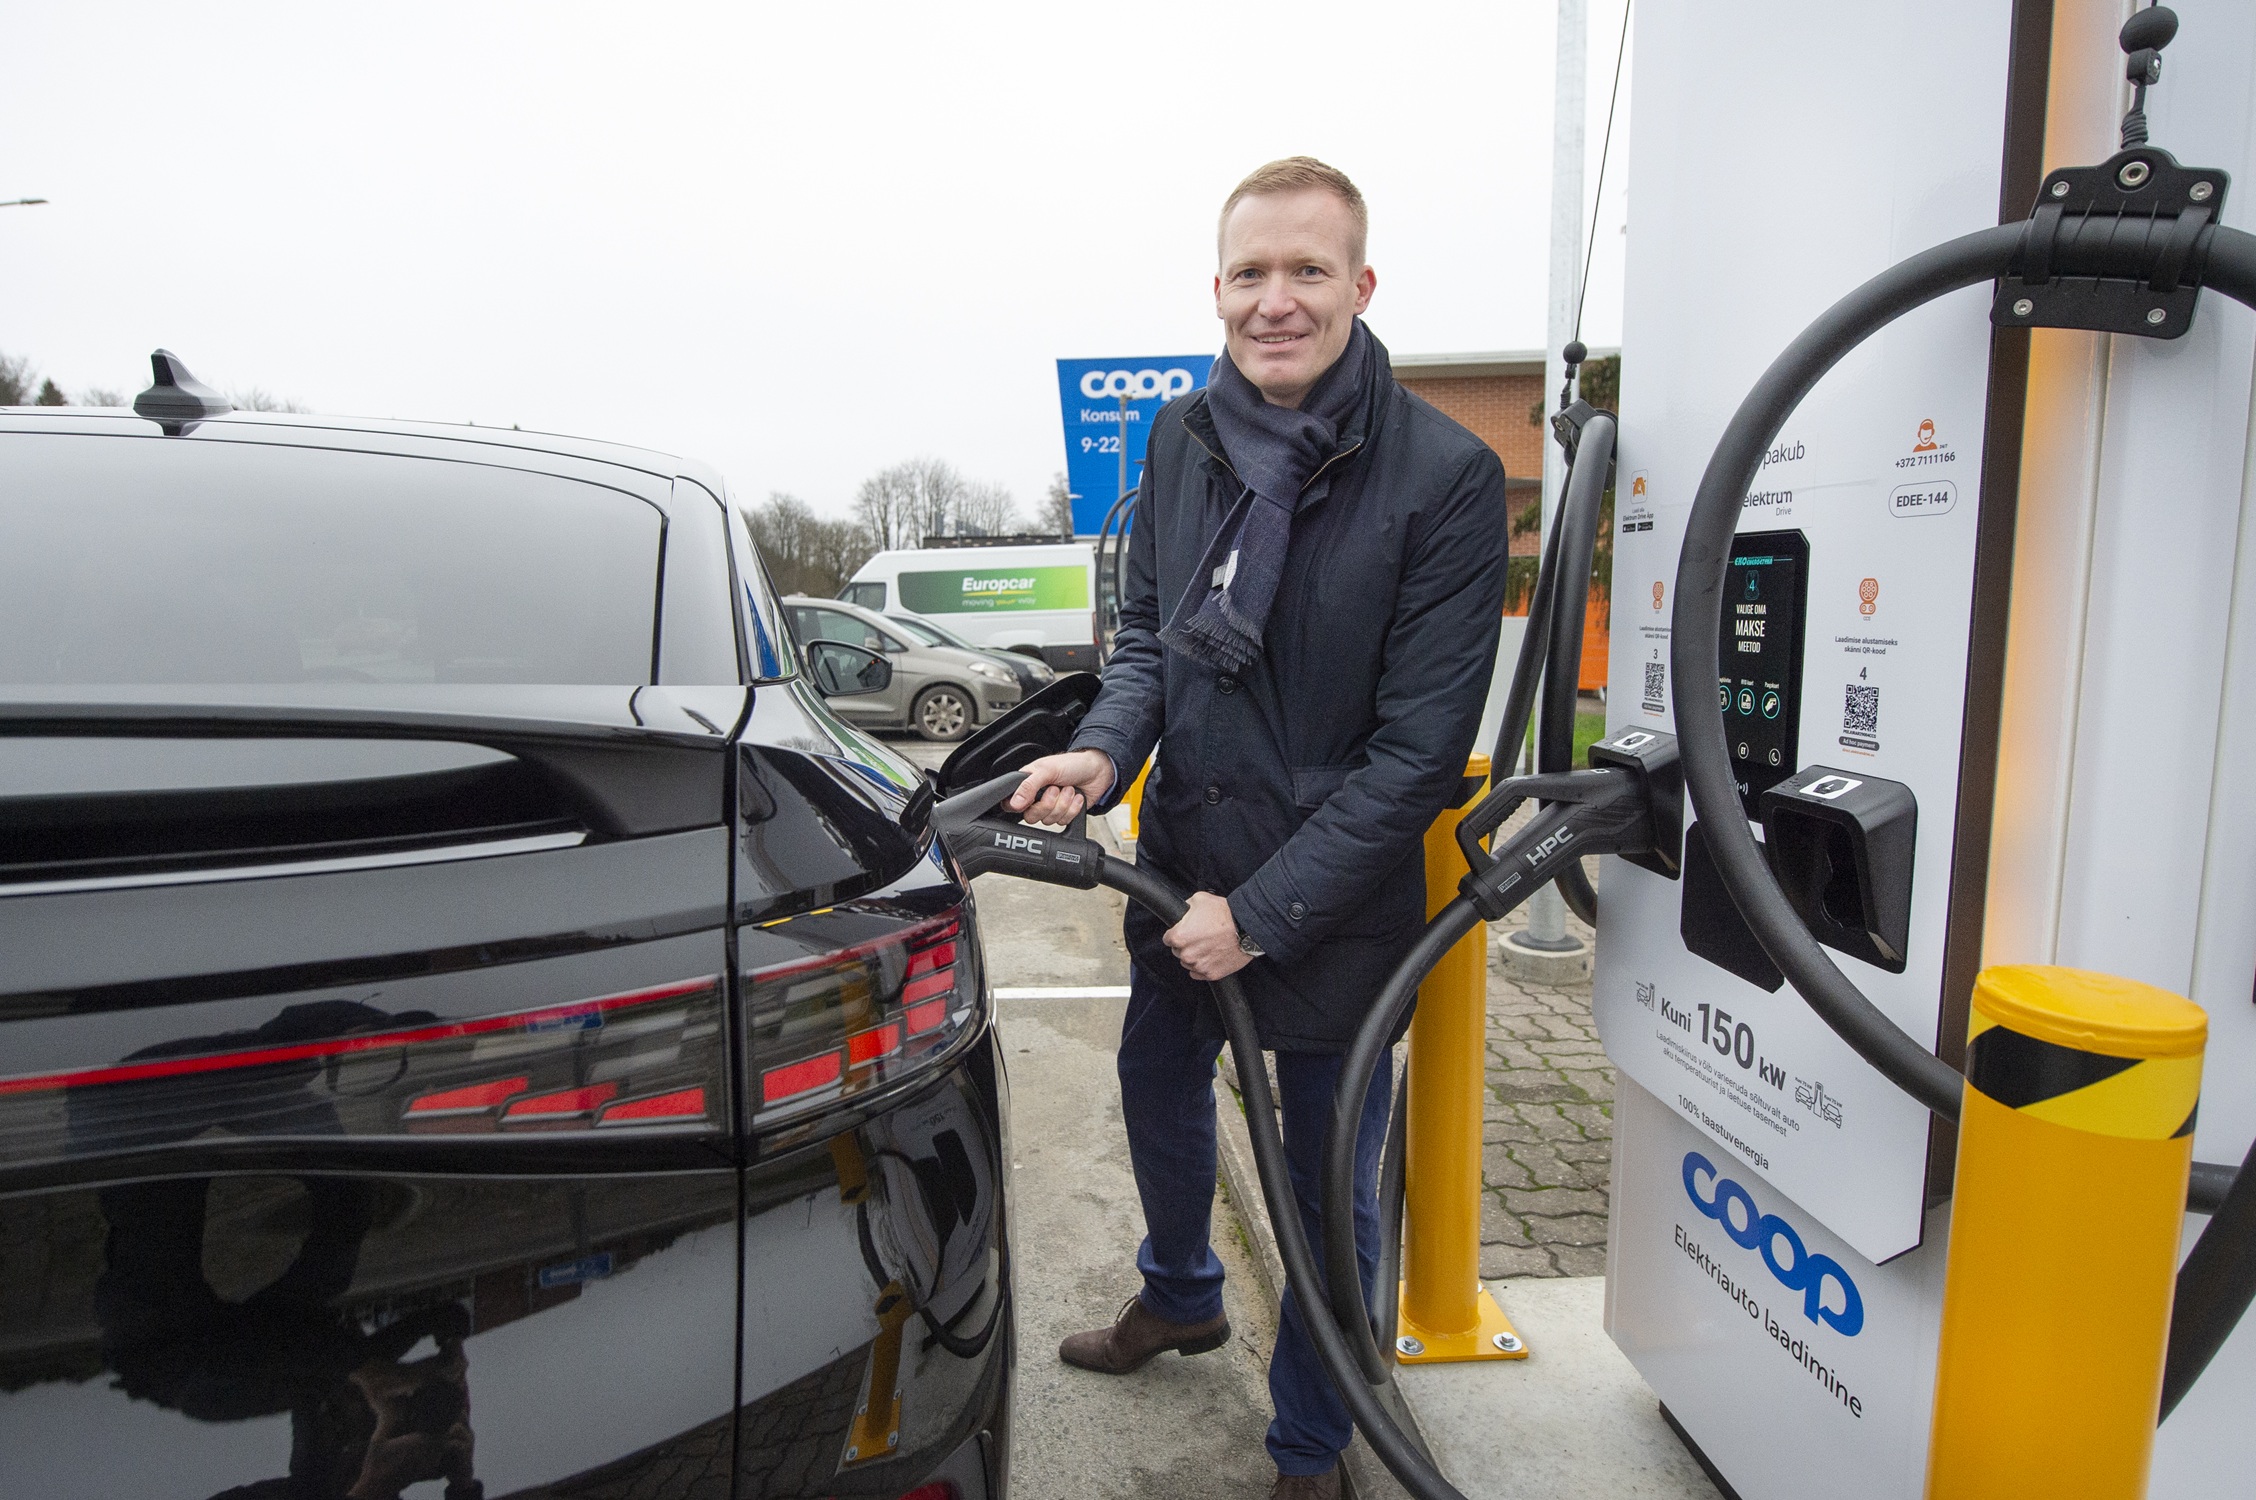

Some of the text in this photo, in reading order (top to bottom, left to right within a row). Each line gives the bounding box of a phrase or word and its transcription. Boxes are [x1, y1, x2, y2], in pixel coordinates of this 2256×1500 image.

[1080, 368, 1194, 401] coop
[1081, 436, 1120, 453] 9-22
[1763, 440, 1805, 470] pakub
[1895, 452, 1956, 468] +372 7111166
[1896, 491, 1948, 507] EDEE-144
[1776, 506, 1792, 516] Drive
[962, 577, 1036, 595] Europcar
[1749, 579, 1755, 591] 4
[1736, 604, 1767, 615] VALIGE OMA
[1735, 619, 1766, 637] MAKSE
[1738, 641, 1760, 653] MEETOD
[1834, 636, 1898, 646] Laadimise alustamiseks
[1844, 645, 1886, 655] skänni QR-kood
[1653, 648, 1658, 659] 3
[1859, 666, 1867, 680] 4
[994, 832, 1043, 854] HPC
[1526, 825, 1574, 866] HPC
[1661, 997, 1787, 1091] Kuni 150 kW
[1656, 1029, 1698, 1064] Laadimiskiirus
[1714, 1068, 1748, 1097] varieeruda
[1782, 1114, 1800, 1131] auto
[1663, 1046, 1787, 1137] aku temperatuurist ja laetuse tasemest
[1678, 1093, 1769, 1170] 100% taastuvenergia
[1682, 1151, 1864, 1337] coop
[1675, 1223, 1862, 1418] Elektriauto laadimine
